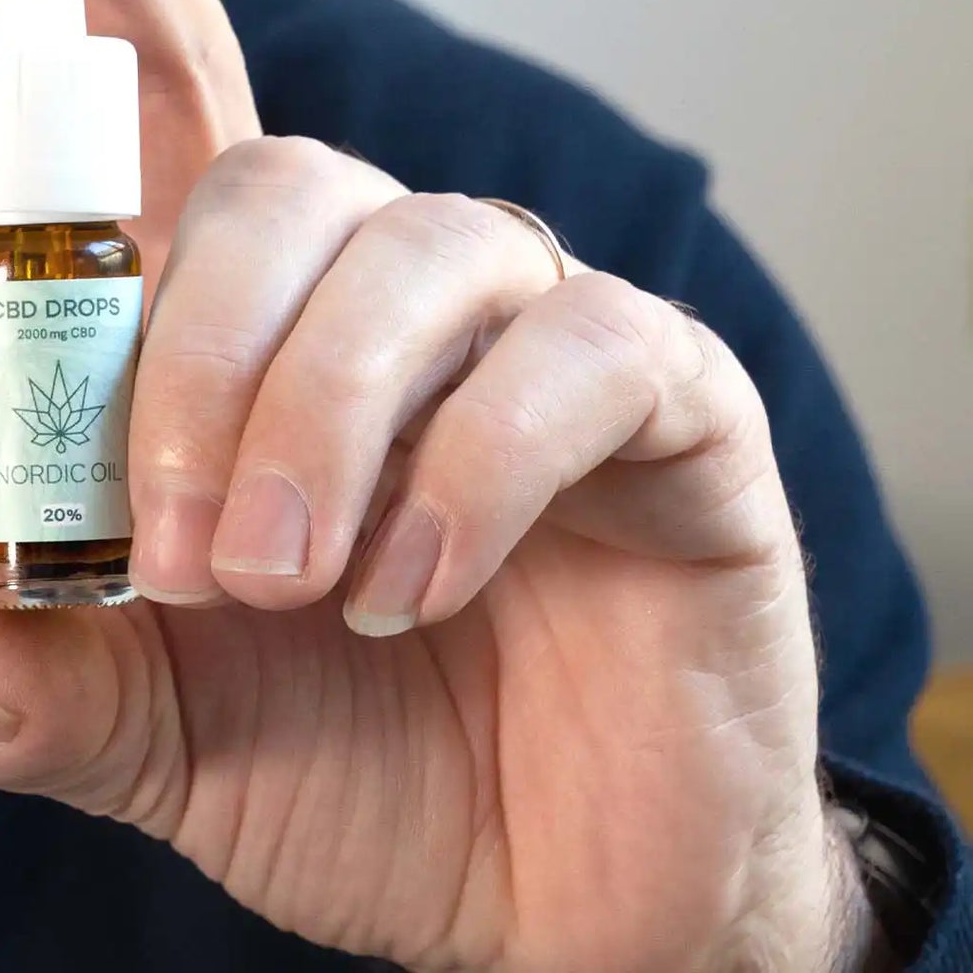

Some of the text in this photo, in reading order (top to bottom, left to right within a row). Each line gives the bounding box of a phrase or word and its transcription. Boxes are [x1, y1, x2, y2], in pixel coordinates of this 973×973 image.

[46, 297, 121, 319] DROPS
[17, 327, 97, 341] 2000 mg CBD
[90, 462, 123, 483] OIL
[43, 508, 83, 522] 20%
